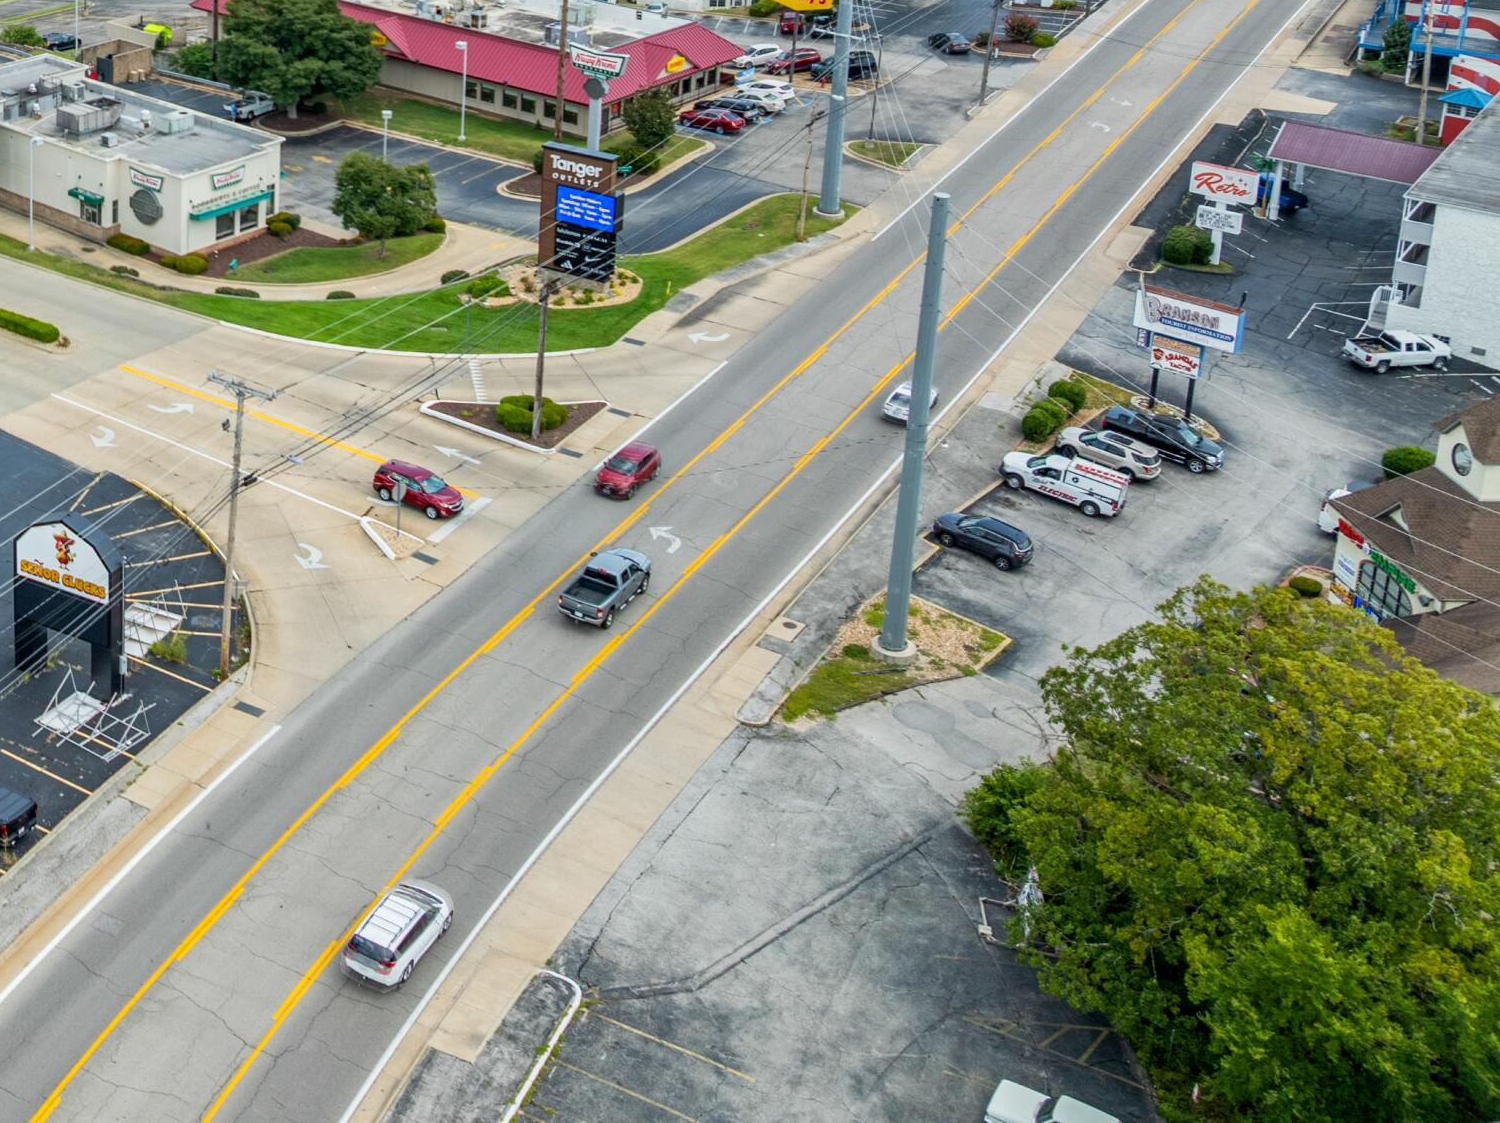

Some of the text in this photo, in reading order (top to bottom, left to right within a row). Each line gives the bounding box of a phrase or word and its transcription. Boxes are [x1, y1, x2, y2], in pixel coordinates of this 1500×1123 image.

[575, 52, 618, 70] Krispy Kreme
[550, 154, 603, 177] Tanger
[552, 172, 599, 188] OUTLETS
[1194, 172, 1251, 196] Retro
[1143, 296, 1220, 329] BRANSON
[1161, 318, 1232, 342] TOURIST INFORMATION
[1038, 485, 1078, 502] ELECTRIC
[20, 559, 106, 599] SEÑOR CLUCKS
